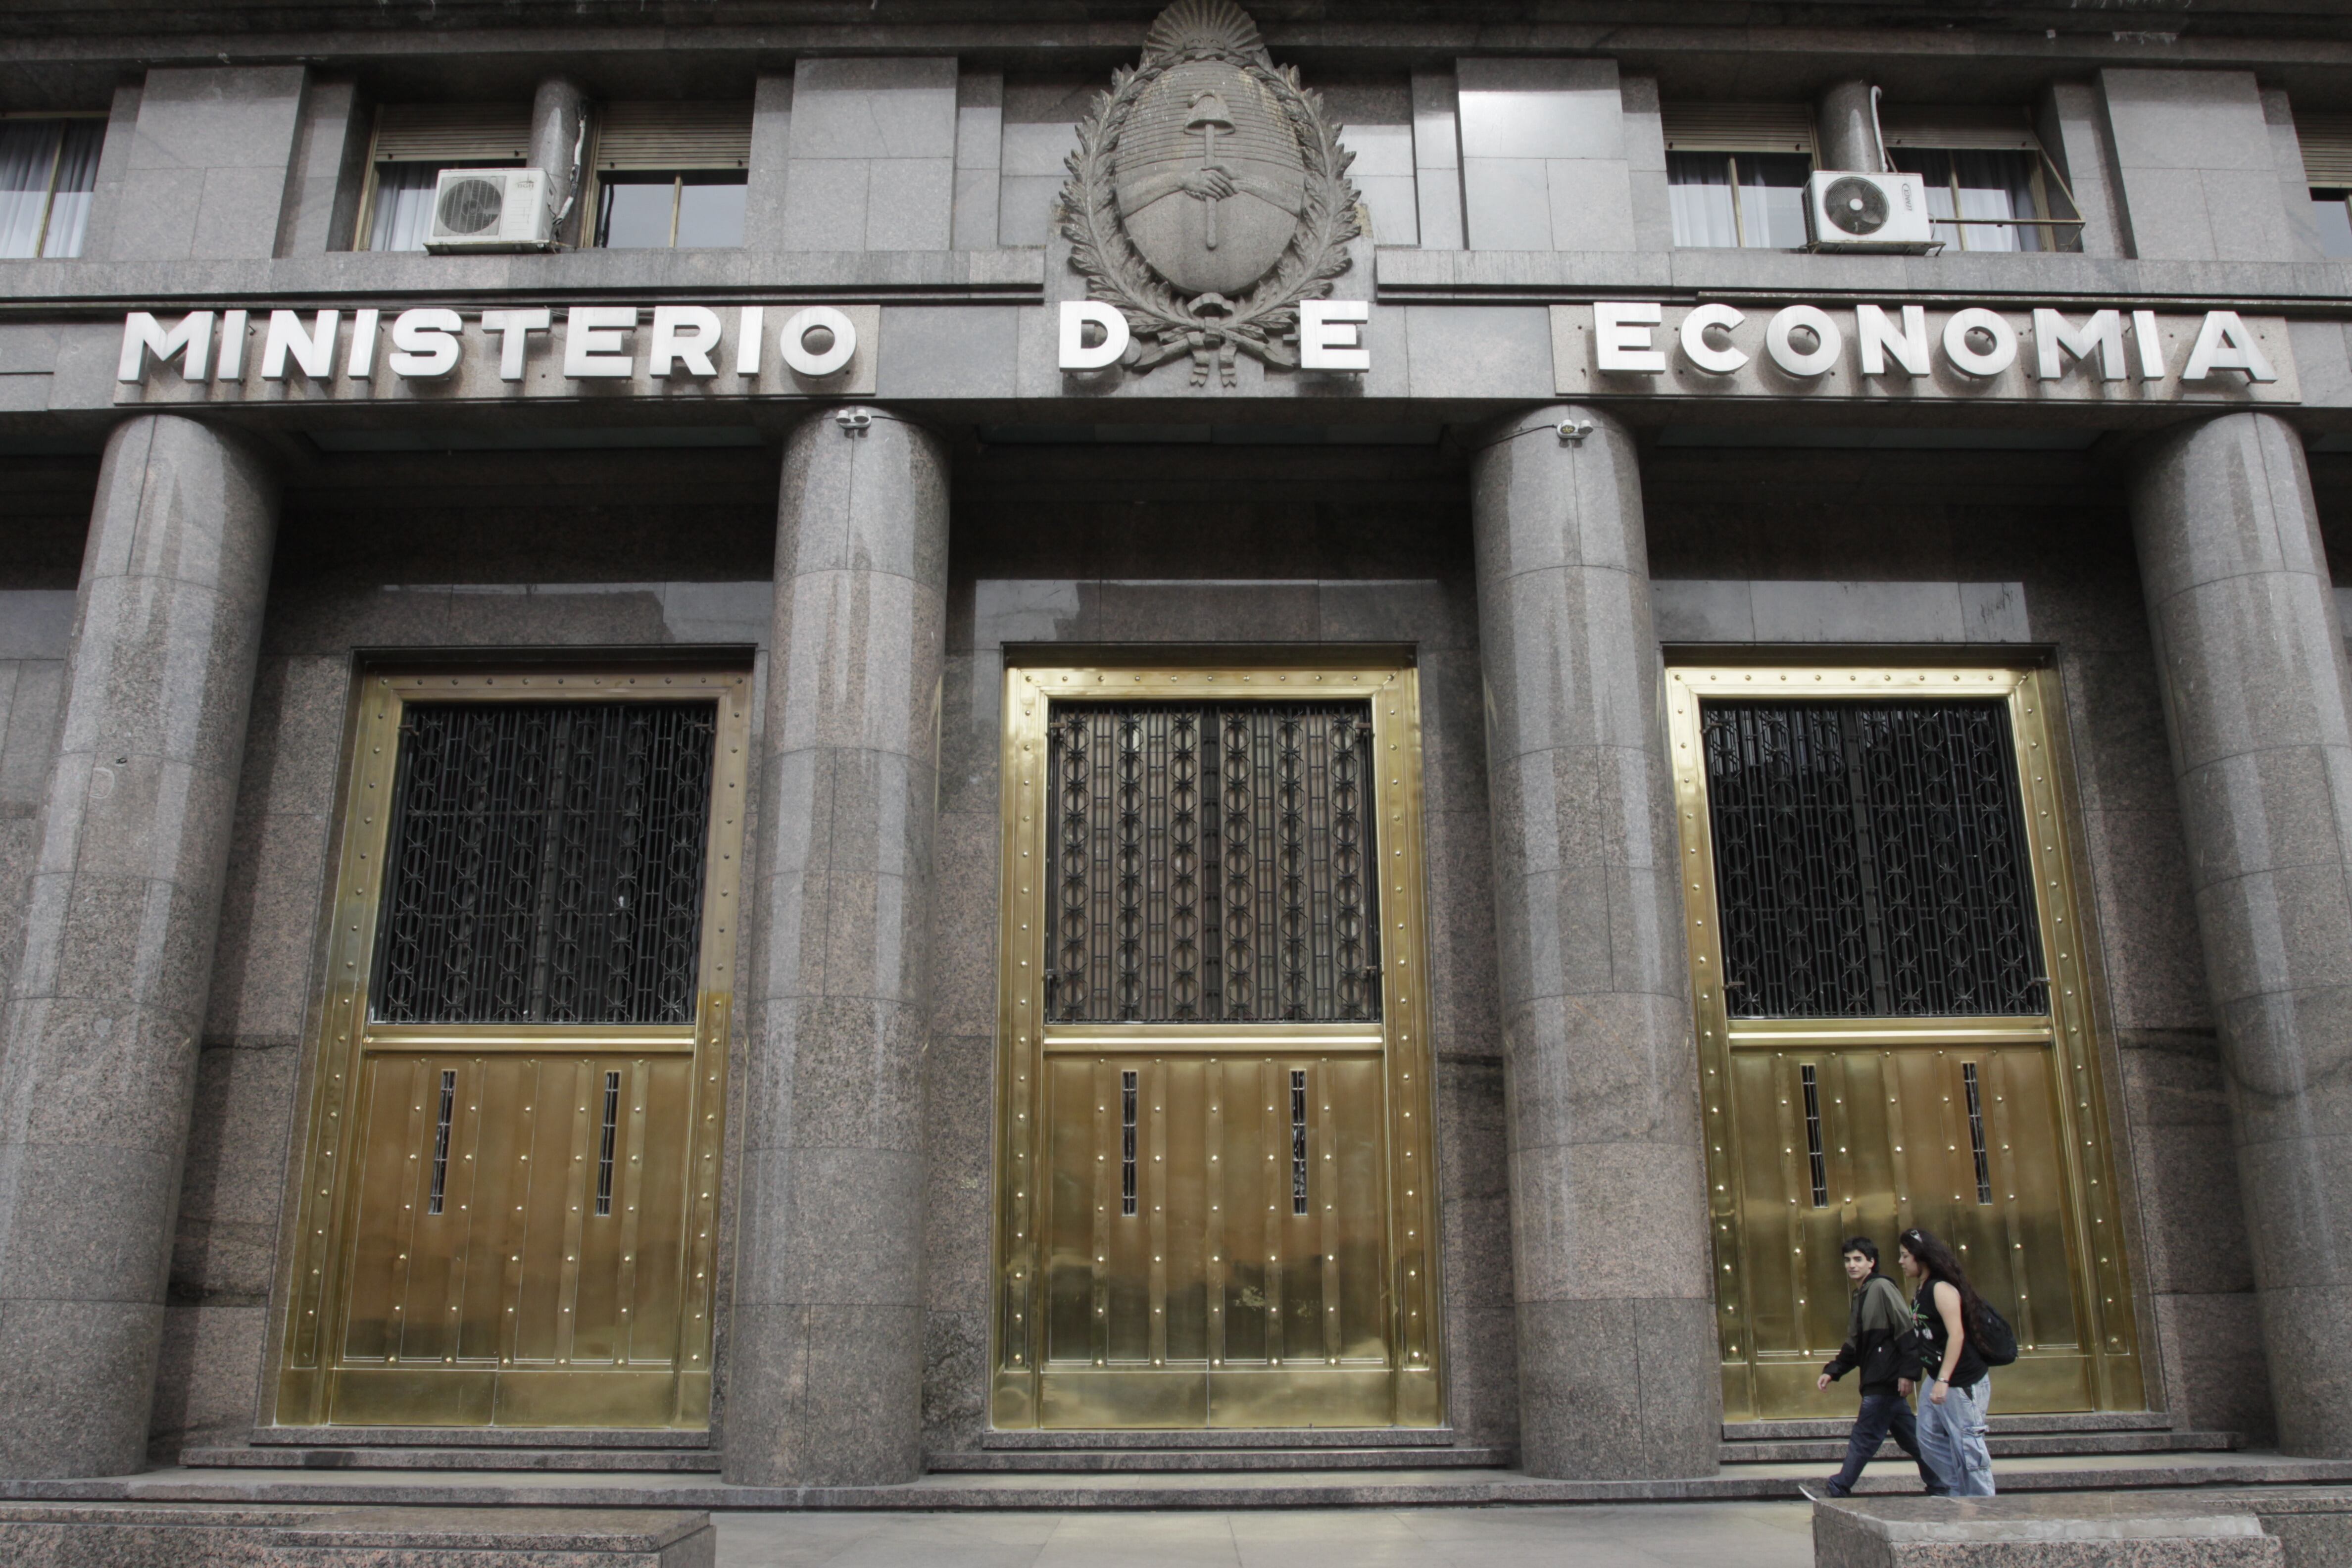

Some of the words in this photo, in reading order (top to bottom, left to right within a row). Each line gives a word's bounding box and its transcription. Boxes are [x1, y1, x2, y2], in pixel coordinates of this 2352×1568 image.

[1904, 190, 1912, 211] LENNOX
[117, 306, 857, 383] MINISTERIO
[1059, 300, 1370, 373] DE
[1593, 302, 2278, 384] ECONOMIA
